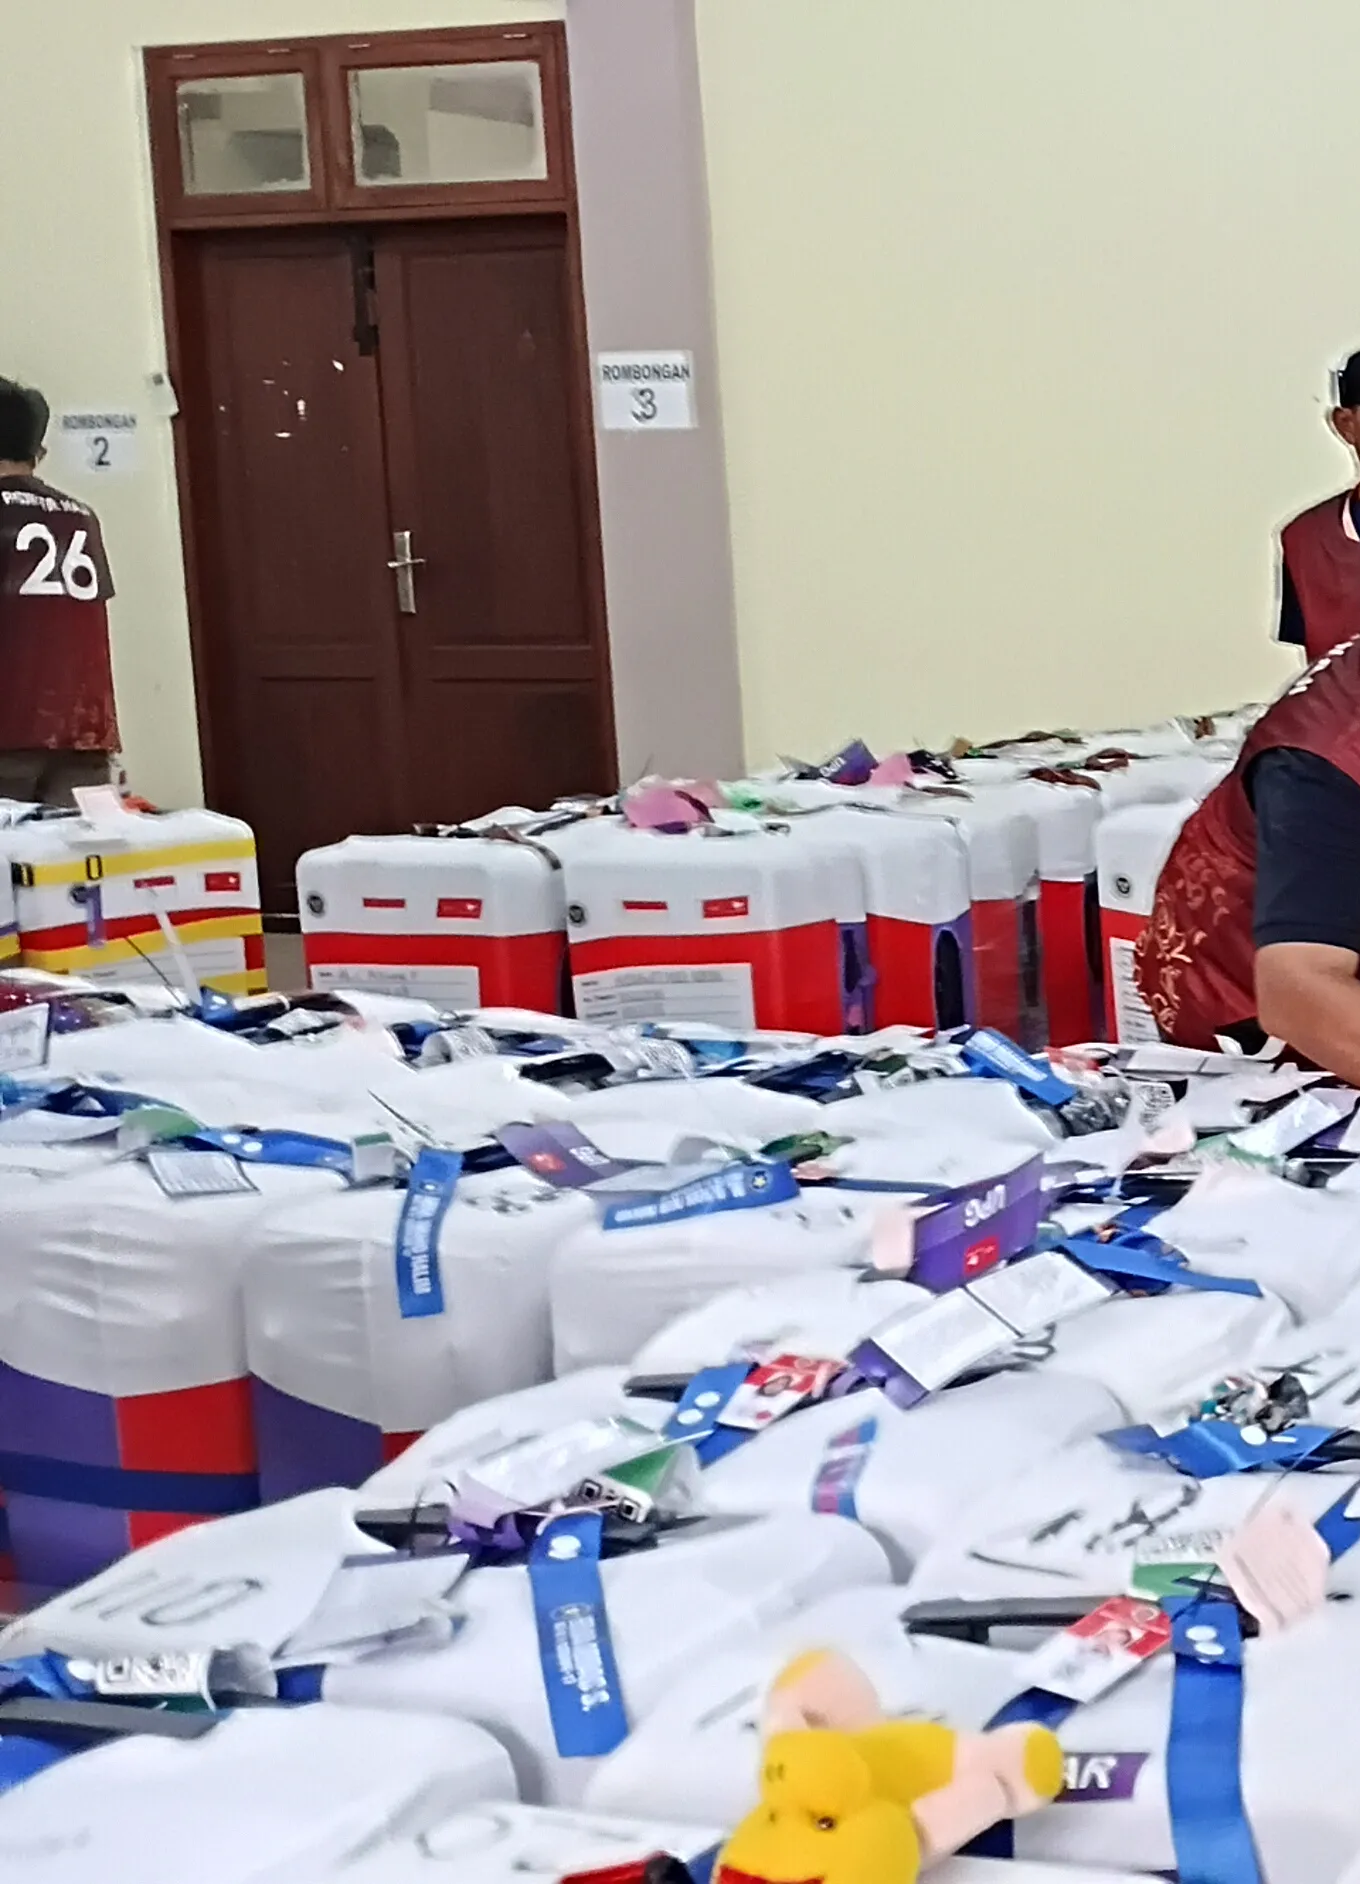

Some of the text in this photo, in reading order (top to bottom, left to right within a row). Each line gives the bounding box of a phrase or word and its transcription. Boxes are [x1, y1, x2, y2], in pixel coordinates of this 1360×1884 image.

[602, 363, 690, 382] ROMBONGAN
[631, 388, 657, 422] 3
[93, 436, 111, 466] 2
[16, 522, 99, 600] 26
